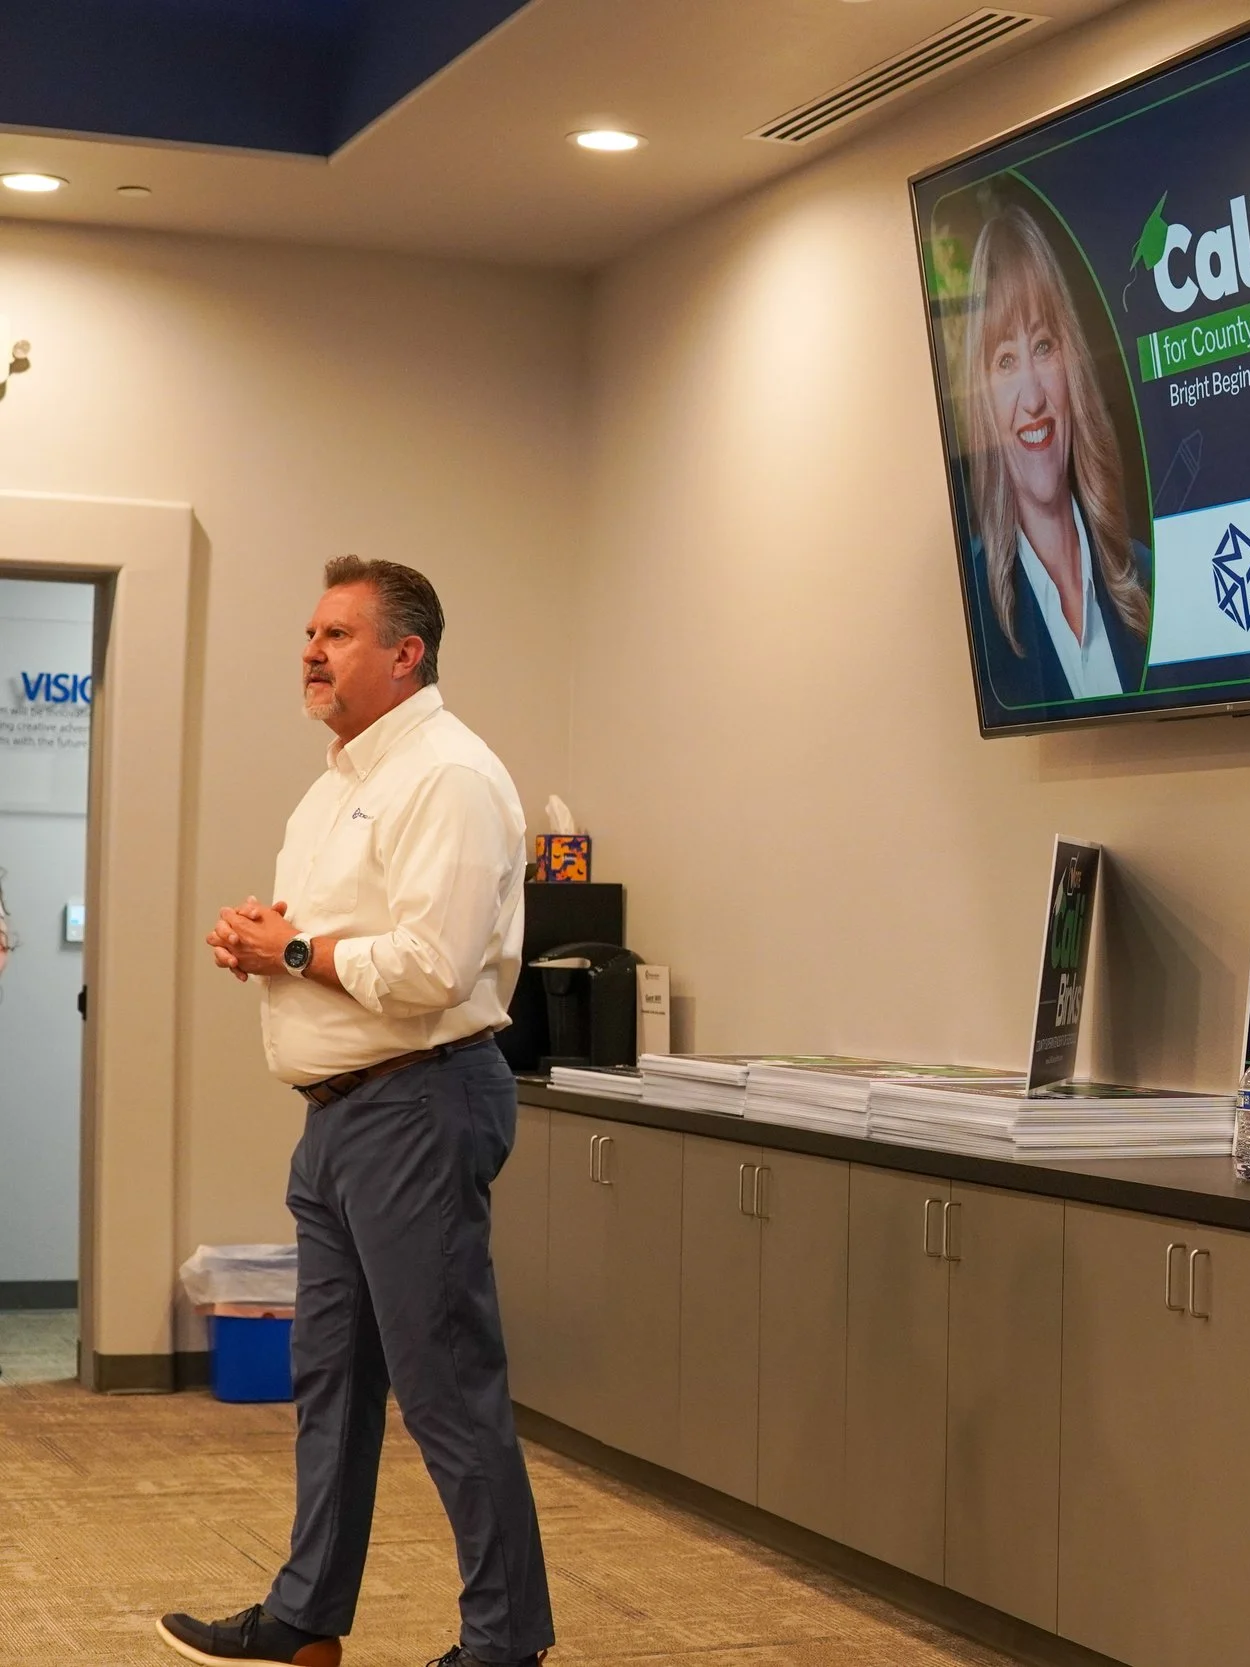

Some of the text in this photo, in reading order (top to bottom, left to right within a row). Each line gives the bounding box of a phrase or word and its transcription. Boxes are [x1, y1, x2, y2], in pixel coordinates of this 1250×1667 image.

[1163, 336, 1187, 365] for
[1170, 376, 1210, 407] Bright
[1055, 973, 1082, 1028] Binks
